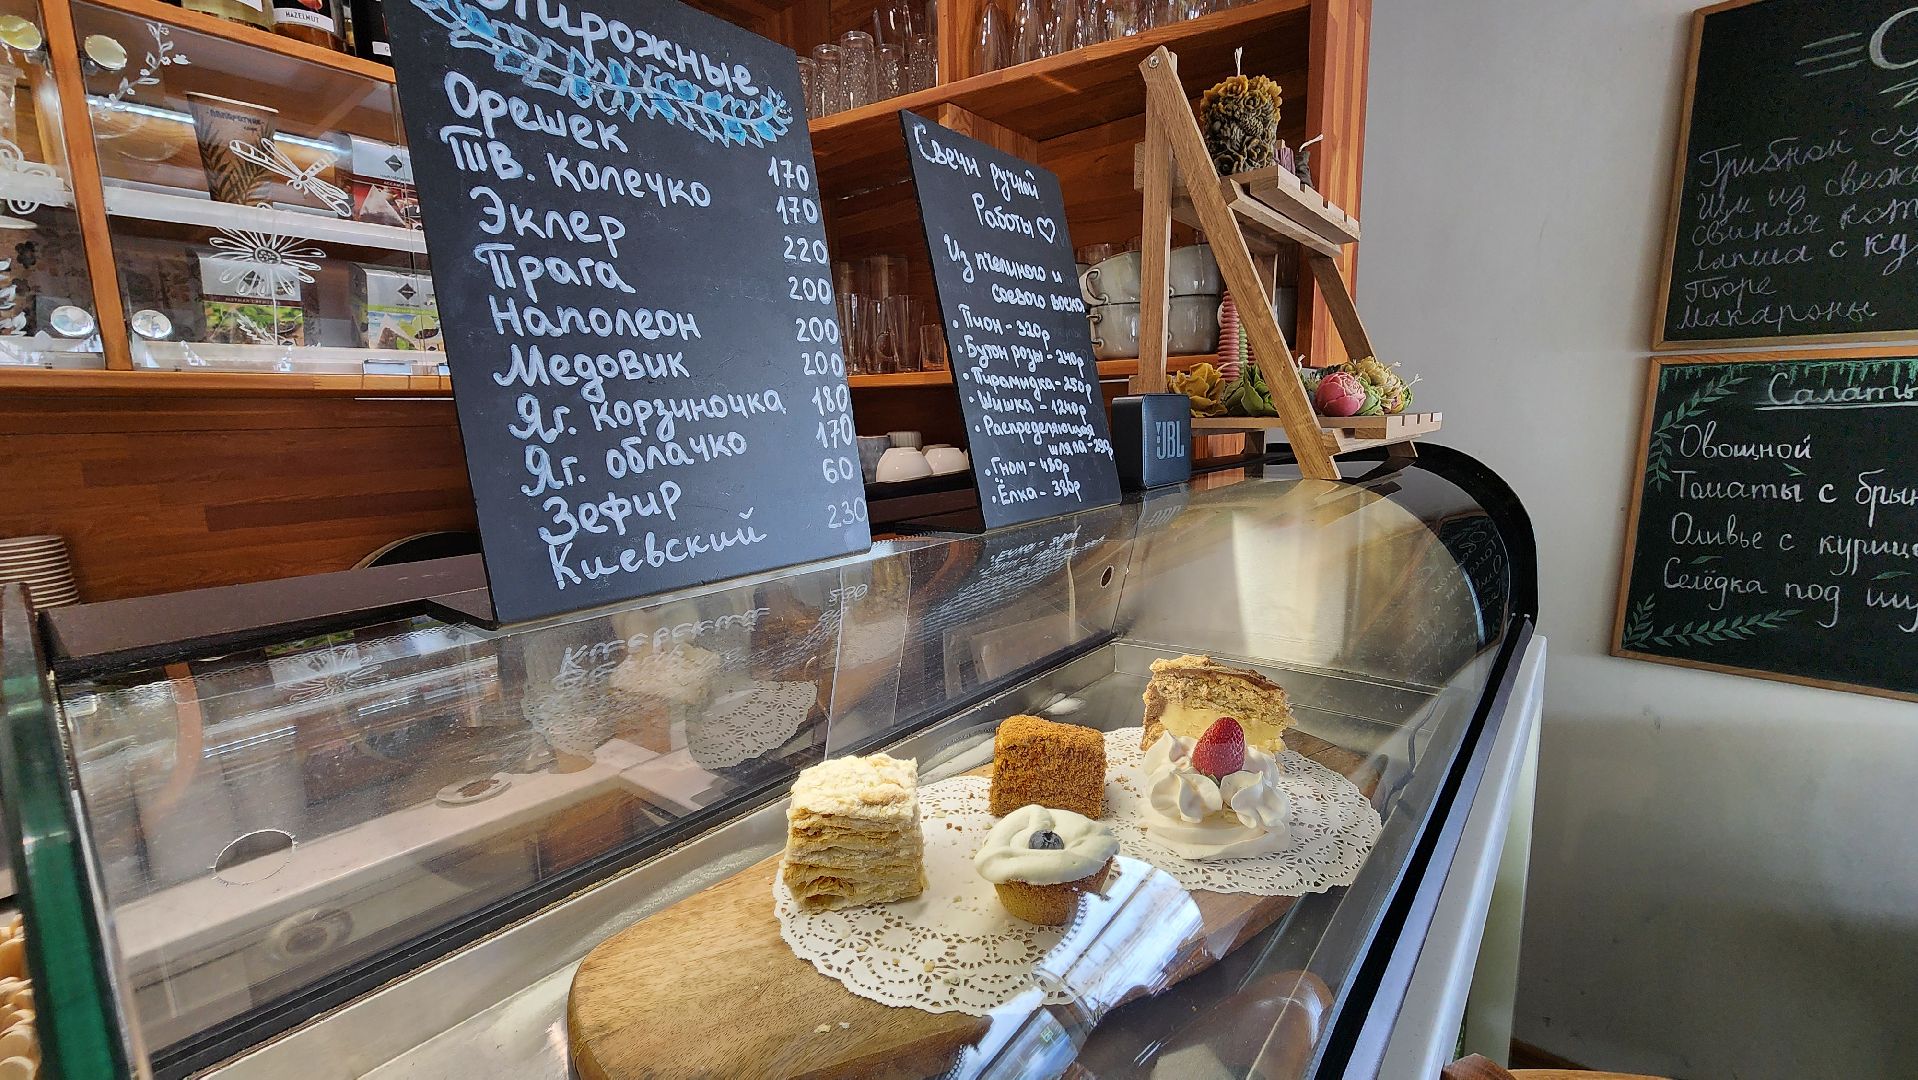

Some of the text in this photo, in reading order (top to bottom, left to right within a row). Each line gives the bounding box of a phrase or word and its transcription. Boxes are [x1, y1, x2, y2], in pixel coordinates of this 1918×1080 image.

[444, 71, 810, 192] Орешек 170
[914, 123, 1039, 202] Свечи ручной
[1698, 128, 1853, 198] Грибной
[547, 153, 712, 209] колечко
[776, 195, 818, 225] 170
[1768, 185, 1806, 216] из
[470, 186, 827, 266] Эклер 220
[972, 192, 1035, 239] Работы
[474, 243, 832, 305] Прага 200
[943, 233, 1064, 284] Из пчелиного и
[1828, 240, 1848, 258] с
[1863, 233, 1918, 276] ку
[1050, 293, 1086, 313] воска
[1684, 275, 1778, 310] Пюре
[488, 294, 839, 345] Наполеон 200
[958, 303, 1004, 335] Пион
[1016, 319, 1050, 351] 320р
[1676, 301, 1878, 333] Макароны
[493, 344, 844, 402] Медовик 200
[963, 334, 1009, 369] Бутон
[1010, 344, 1044, 373] розы
[1055, 349, 1085, 379] 240р
[508, 383, 850, 444] Яг. корзиночка 180
[976, 389, 1035, 415] Шишка
[982, 414, 1095, 446] Распределяющая
[1155, 420, 1185, 460] JBL
[1679, 420, 1813, 461] Овощной
[520, 414, 854, 497] Яг. облачко 170
[990, 456, 1028, 477] Гном
[1039, 457, 1070, 478] 480р
[538, 456, 853, 545] Зефир 60
[995, 477, 1038, 505] Ёлка
[1051, 478, 1082, 502] 380р
[1671, 469, 1804, 503] Томаты
[1818, 483, 1838, 504] с
[548, 497, 867, 589] Киевский 230
[1671, 511, 1764, 549] Оливье
[1779, 533, 1796, 551] с
[1663, 557, 1769, 611] Селёдка
[1785, 583, 1841, 628] под
